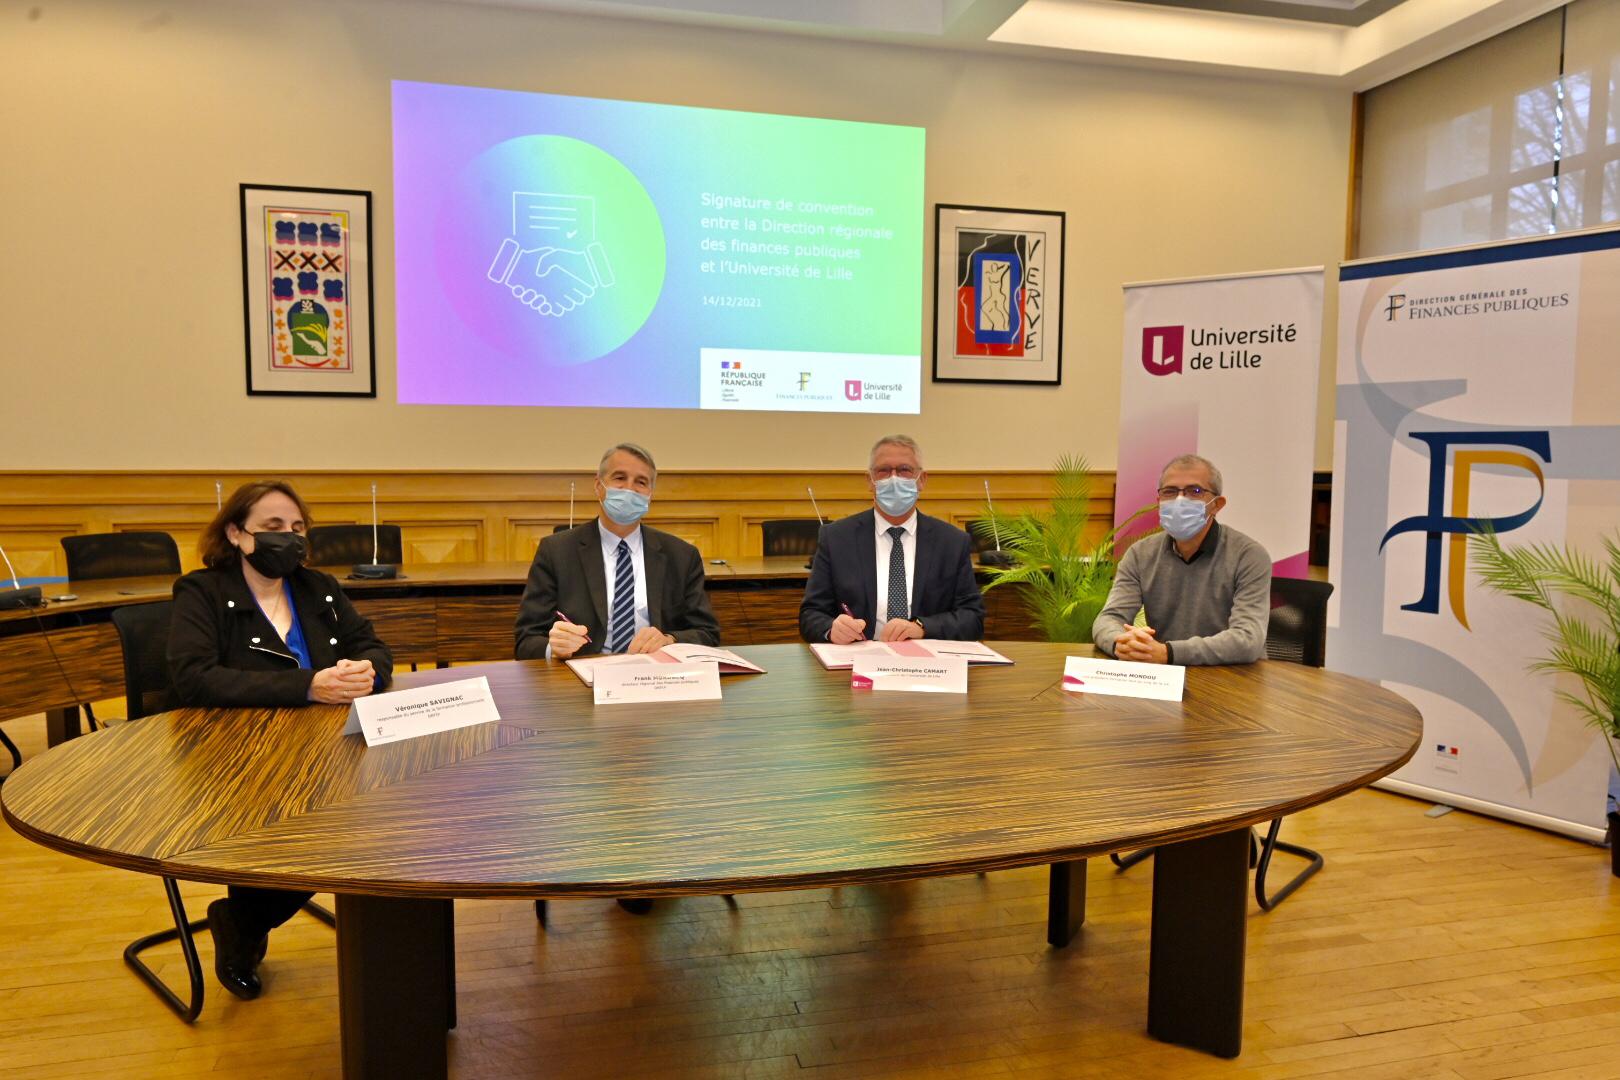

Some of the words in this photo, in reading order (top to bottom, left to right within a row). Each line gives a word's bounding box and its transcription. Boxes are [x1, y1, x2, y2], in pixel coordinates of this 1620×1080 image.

[701, 193, 771, 209] Signature
[776, 198, 793, 211] de
[800, 201, 874, 216] convention
[701, 217, 739, 230] entre
[744, 219, 757, 231] la
[762, 219, 824, 235] Direction
[830, 225, 893, 242] régionale
[701, 237, 727, 251] des
[731, 238, 790, 255] finances
[795, 244, 861, 261] publiques
[701, 261, 716, 274] et
[804, 266, 821, 279] de
[826, 267, 853, 281] Lille
[702, 296, 762, 308] 14/12/2021
[1024, 239, 1041, 350] VERVE
[1409, 295, 1456, 306] DIRECTION
[1459, 290, 1505, 301] GÉNÉRALE
[1509, 288, 1528, 297] DES
[1408, 303, 1480, 320] FINANCES
[1483, 293, 1569, 313] PUBLIQUES
[1190, 323, 1297, 347] Université
[1190, 352, 1214, 370] de
[1219, 350, 1262, 369] Lille
[721, 371, 766, 380] RÉPUBLIQUE
[721, 379, 763, 388] FRANÇAISE
[863, 382, 903, 392] Université
[863, 392, 874, 400] de
[874, 392, 891, 401] Lille
[1095, 670, 1128, 678] Christophe
[395, 702, 429, 712] Véronique
[429, 695, 464, 706] SAVIGNAC
